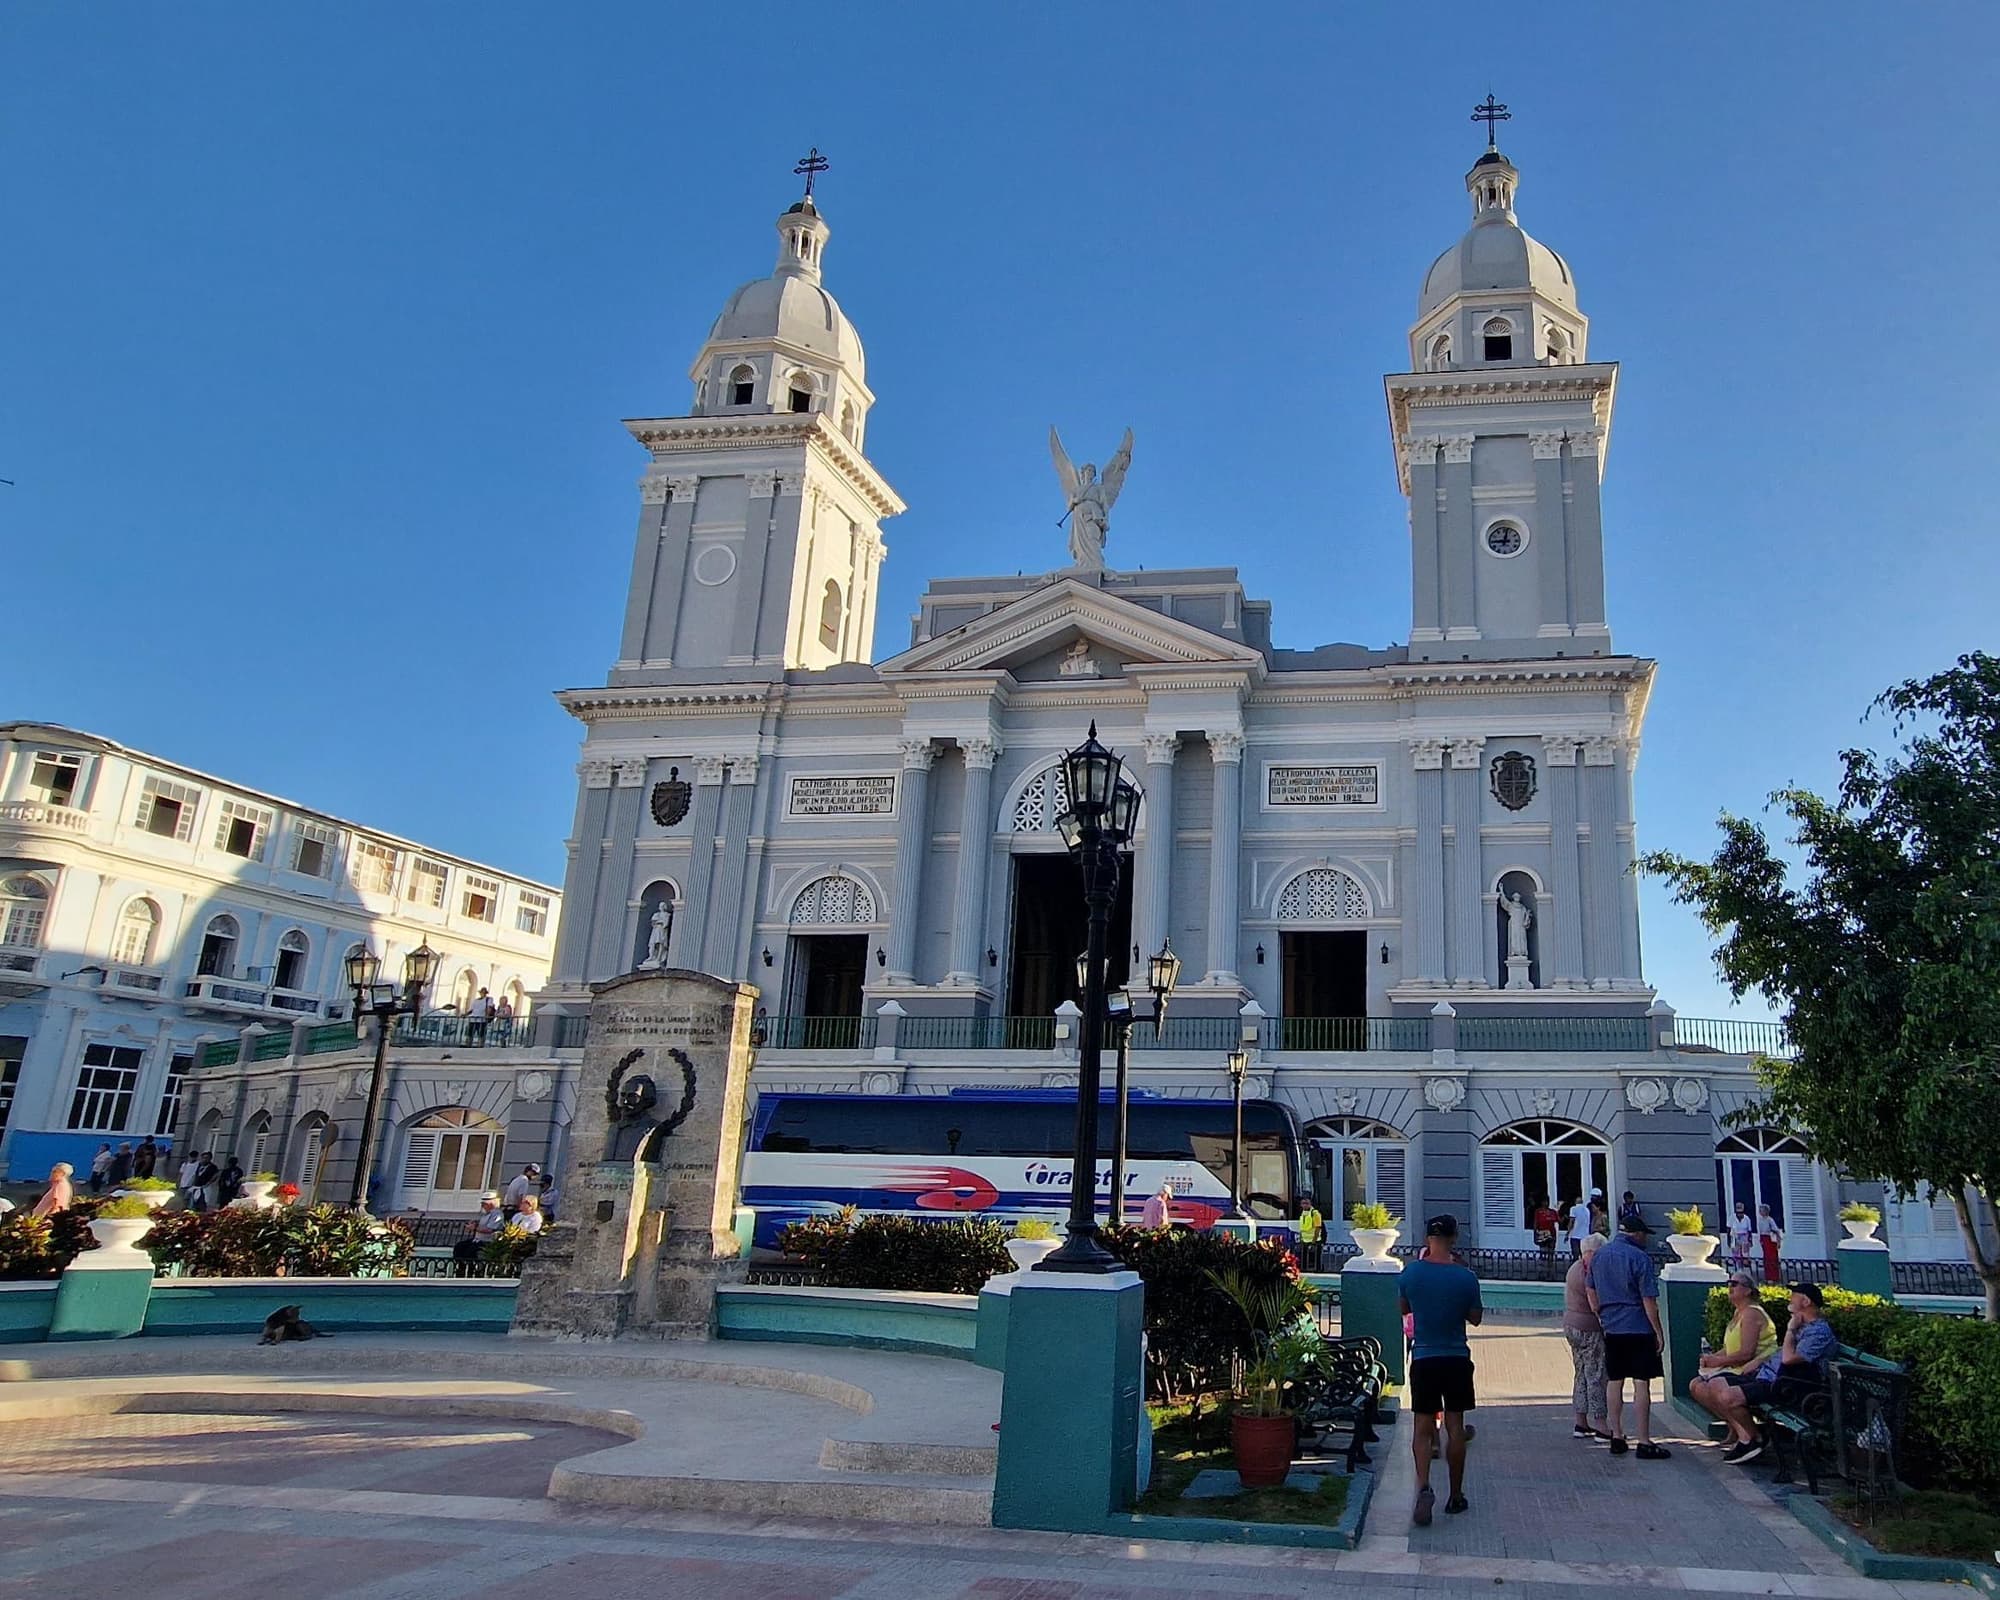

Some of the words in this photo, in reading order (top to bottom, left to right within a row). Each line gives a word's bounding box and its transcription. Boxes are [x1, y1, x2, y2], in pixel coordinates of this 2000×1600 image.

[1274, 769, 1336, 777] METROPOLITANA
[1338, 768, 1372, 776] ECCLESIA
[799, 780, 849, 788] CATHEDRALIS
[856, 779, 887, 787] ECCLESIA
[811, 797, 820, 805] IN
[1284, 795, 1306, 803] ANNO
[1309, 794, 1337, 802] DOMINI
[828, 804, 855, 812] DOMINI
